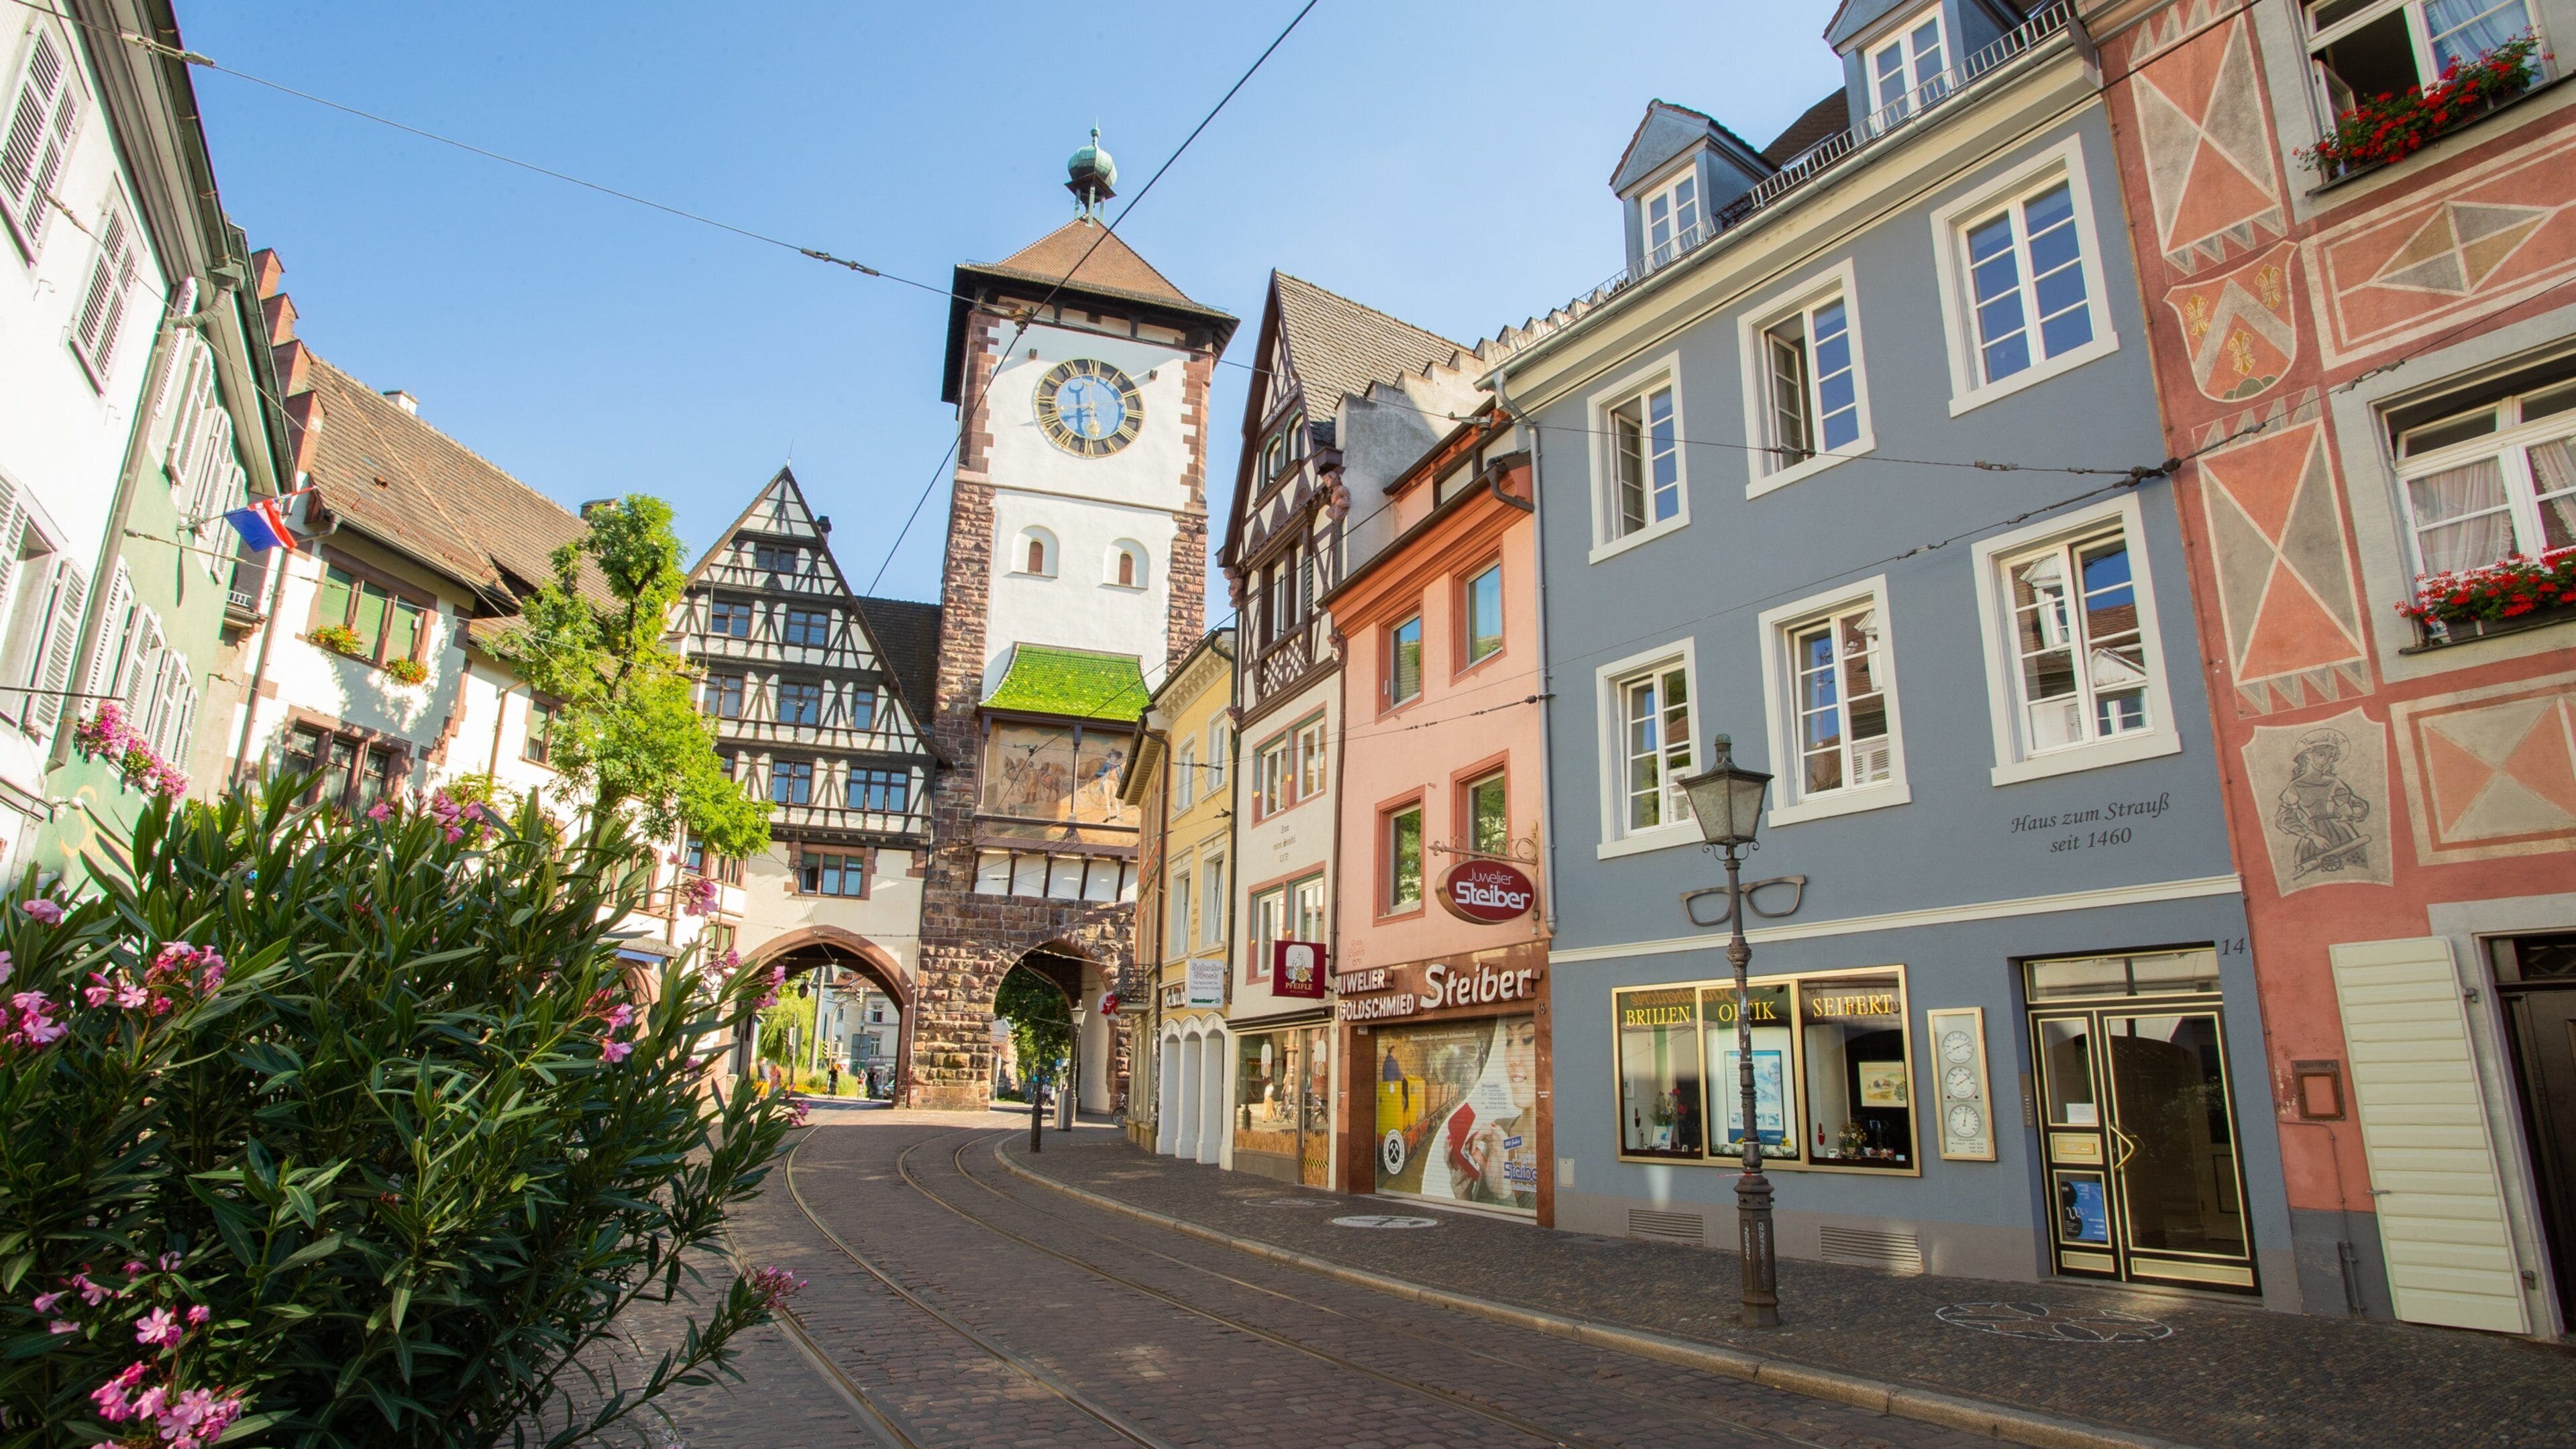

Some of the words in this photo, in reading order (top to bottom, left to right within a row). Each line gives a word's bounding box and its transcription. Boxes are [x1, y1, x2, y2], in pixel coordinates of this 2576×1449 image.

[2011, 814, 2057, 833] Haus
[2062, 809, 2100, 825] zum
[2104, 792, 2170, 820] Strauß
[2050, 835, 2080, 853] seit
[2087, 827, 2133, 848] 1460
[1468, 868, 1513, 885] Juwelier
[1455, 881, 1530, 909] Steiber
[2221, 937, 2245, 955] 14
[1285, 982, 1313, 990] PFEIFLE
[1334, 968, 1385, 994] JUWELIER
[1420, 962, 1534, 1008] Steiber
[1340, 994, 1414, 1020] GOLDSCHMIED
[1538, 1003, 1546, 1014] 16
[1625, 1006, 1690, 1026] BRILLEN
[1813, 994, 1893, 1018] SEIFERT
[1503, 1161, 1537, 1181] Steibe
